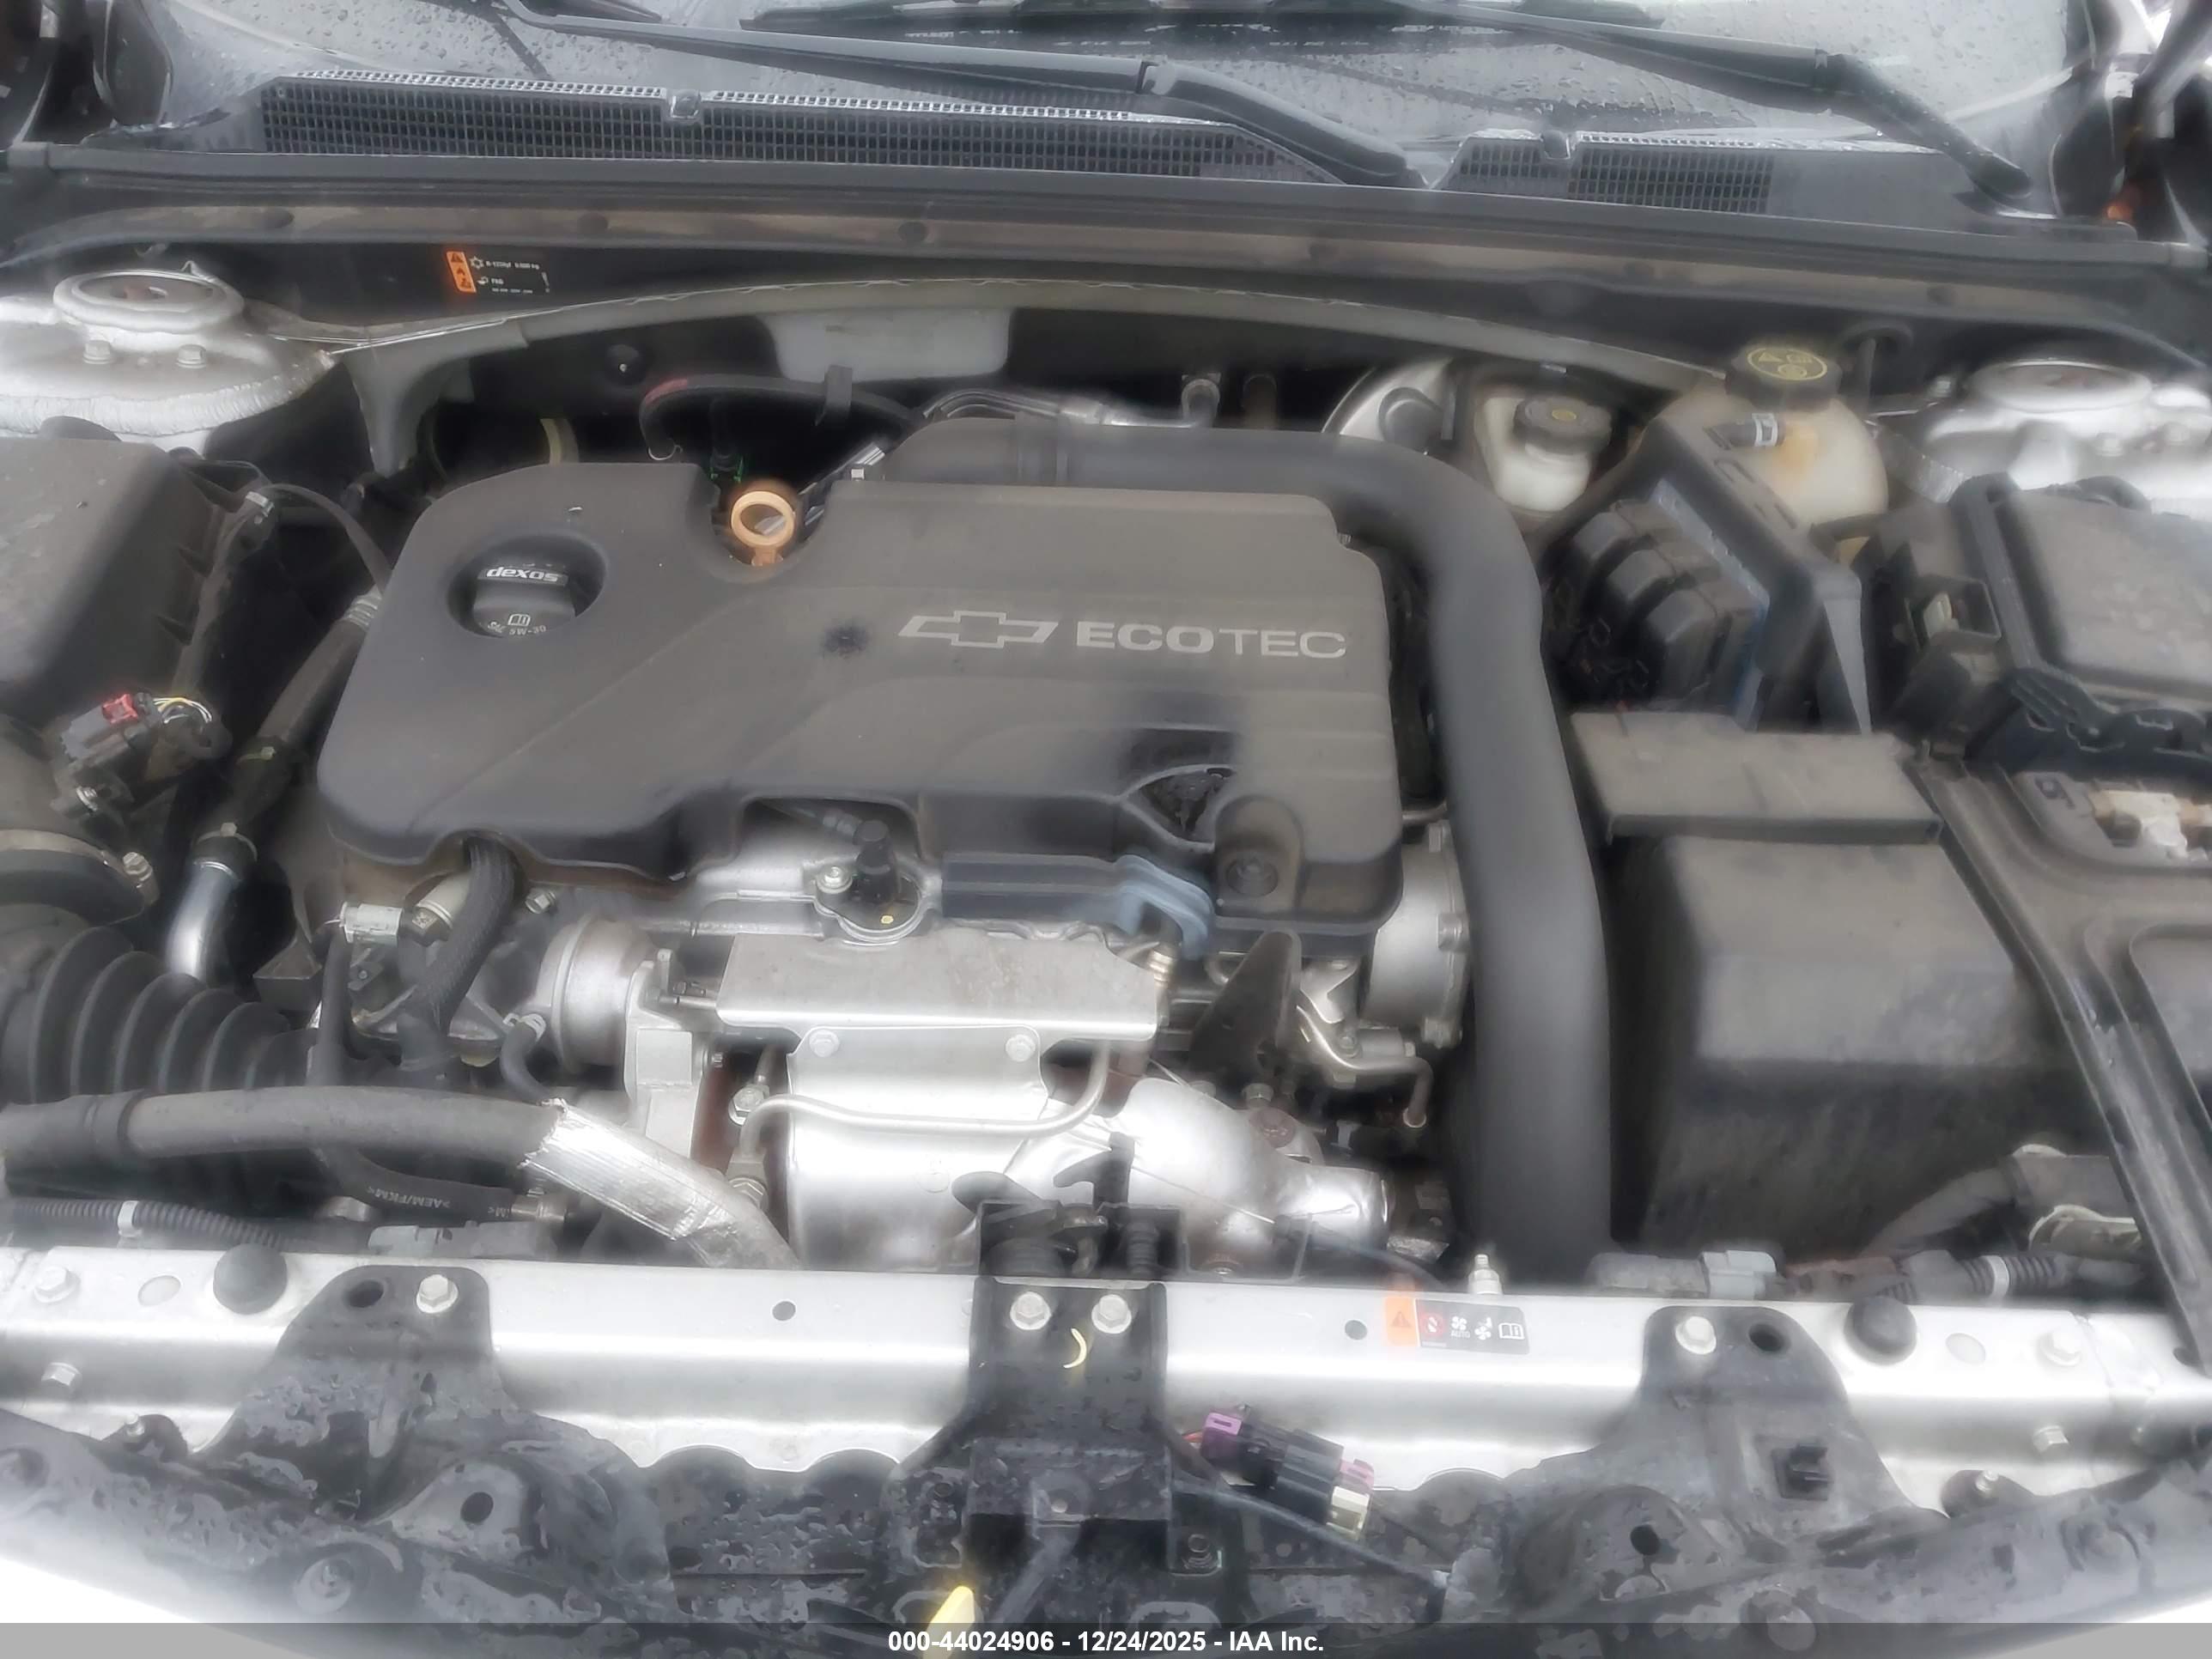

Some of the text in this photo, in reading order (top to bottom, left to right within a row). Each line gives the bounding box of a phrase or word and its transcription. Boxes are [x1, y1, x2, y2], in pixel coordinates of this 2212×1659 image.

[486, 566, 560, 582] dexos
[508, 623, 547, 635] 5W-30
[1077, 621, 1346, 659] ECOTEC
[1450, 1330, 1471, 1340] AUTO
